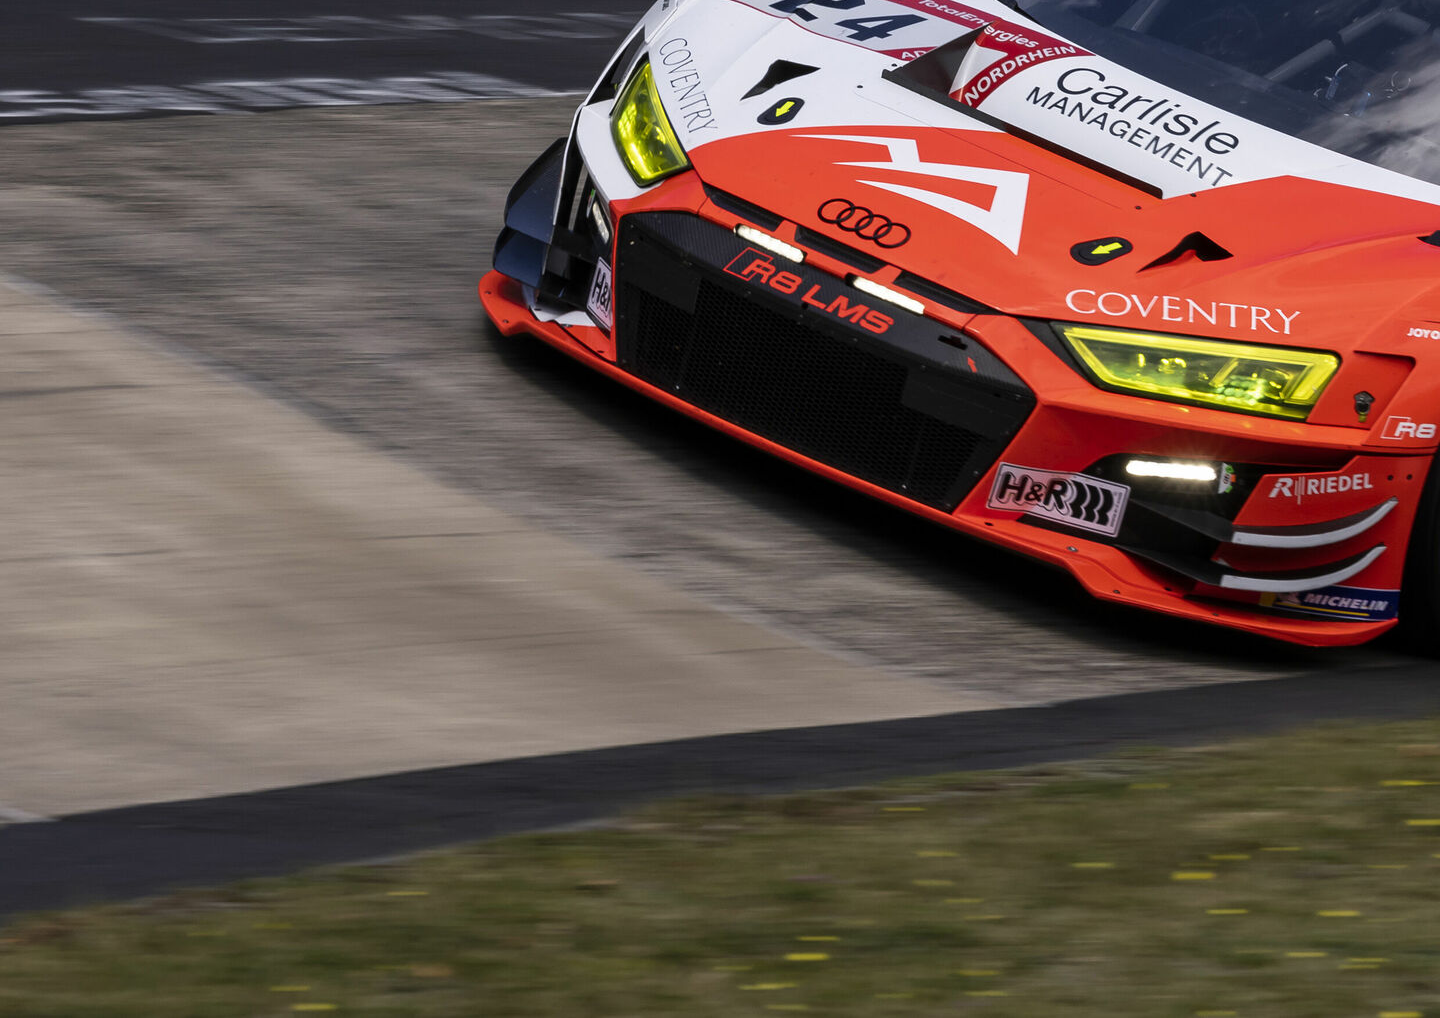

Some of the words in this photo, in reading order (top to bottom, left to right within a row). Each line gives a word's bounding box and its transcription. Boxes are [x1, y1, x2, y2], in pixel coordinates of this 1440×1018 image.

[659, 37, 718, 133] COVENTRY
[963, 45, 1076, 107] NORDRHEIN
[1026, 86, 1233, 187] MANAGEMENT
[1057, 67, 1239, 155] Carlisle
[741, 258, 802, 294] R8
[801, 284, 894, 334] LMS
[1065, 289, 1300, 335] COVENTRY
[1394, 422, 1436, 438] R8
[996, 471, 1070, 515] H&R
[1307, 472, 1373, 495] RIEDEL
[1303, 593, 1389, 611] MICHELIN
